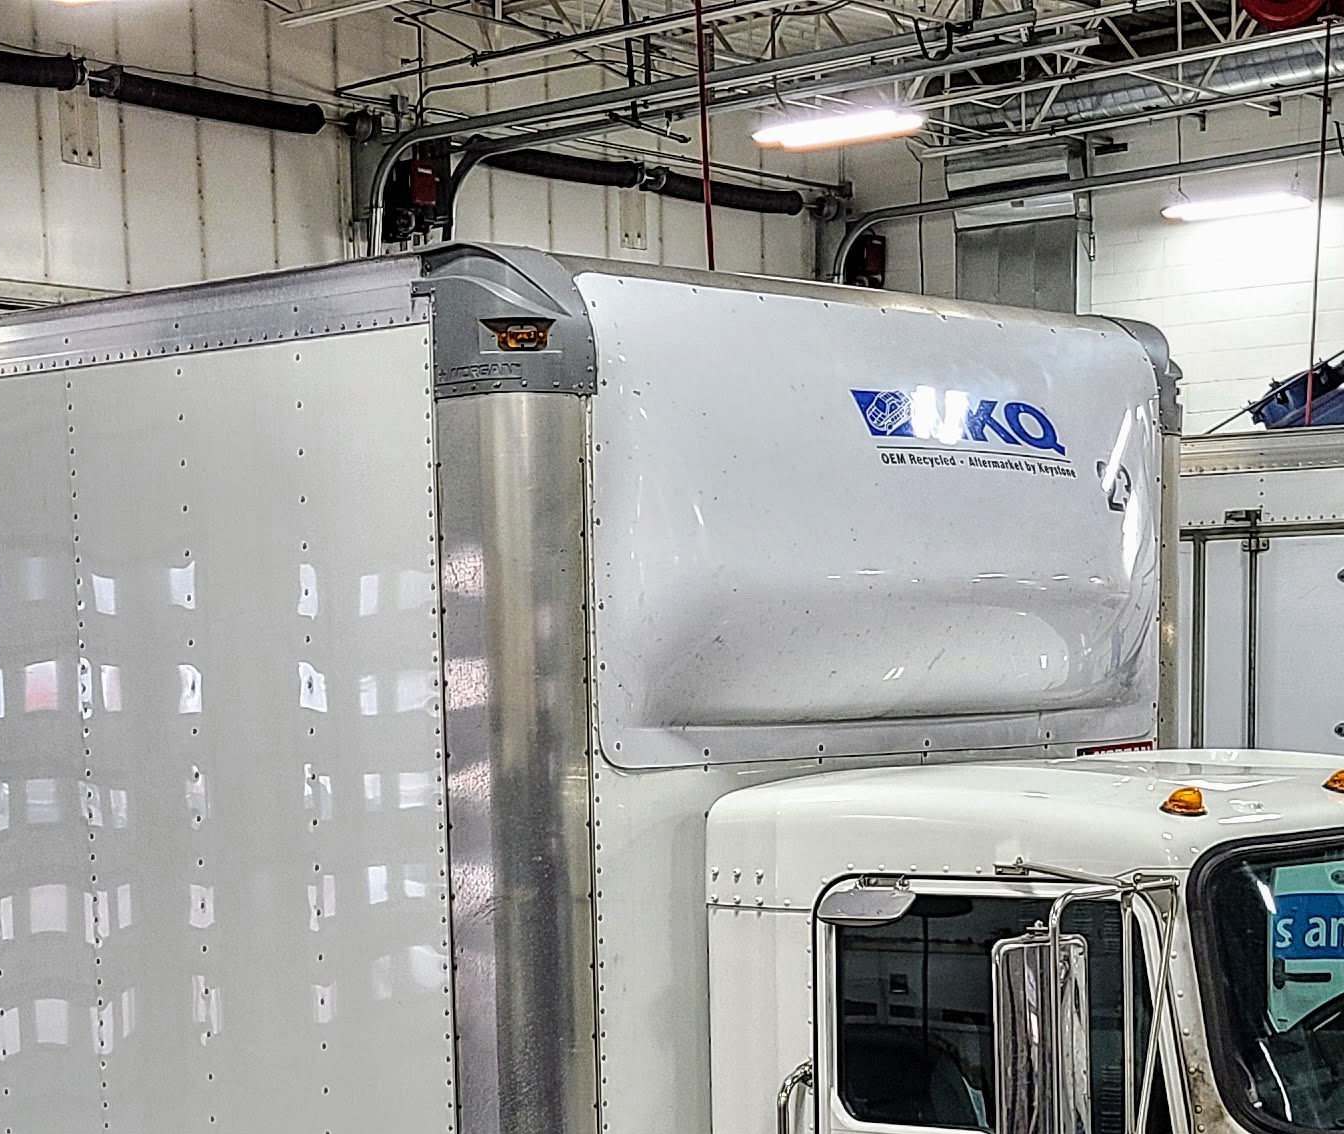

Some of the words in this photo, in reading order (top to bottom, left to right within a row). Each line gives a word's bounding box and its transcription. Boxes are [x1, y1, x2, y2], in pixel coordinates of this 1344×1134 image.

[918, 399, 1066, 456] KQ
[881, 453, 906, 465] OEM
[909, 454, 957, 468] Recycled
[968, 456, 1025, 472] Aftermarket
[1025, 461, 1037, 475] by
[1037, 462, 1077, 478] Keystone
